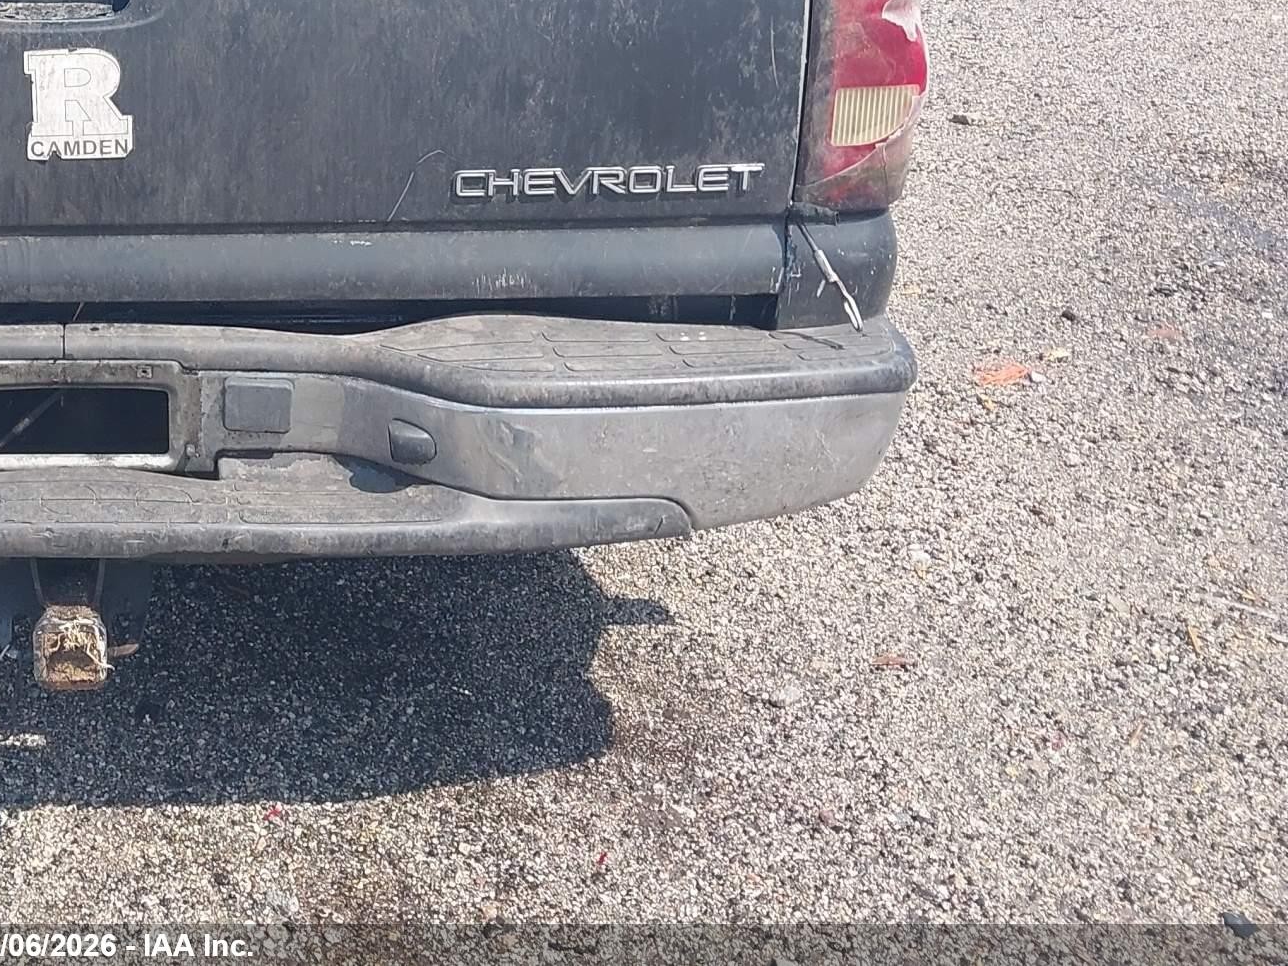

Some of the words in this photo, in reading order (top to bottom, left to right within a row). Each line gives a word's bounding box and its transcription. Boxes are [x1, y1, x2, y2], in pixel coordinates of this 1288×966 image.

[25, 48, 133, 137] R
[30, 139, 129, 157] CAMDEN
[454, 163, 765, 198] CHEVROLET
